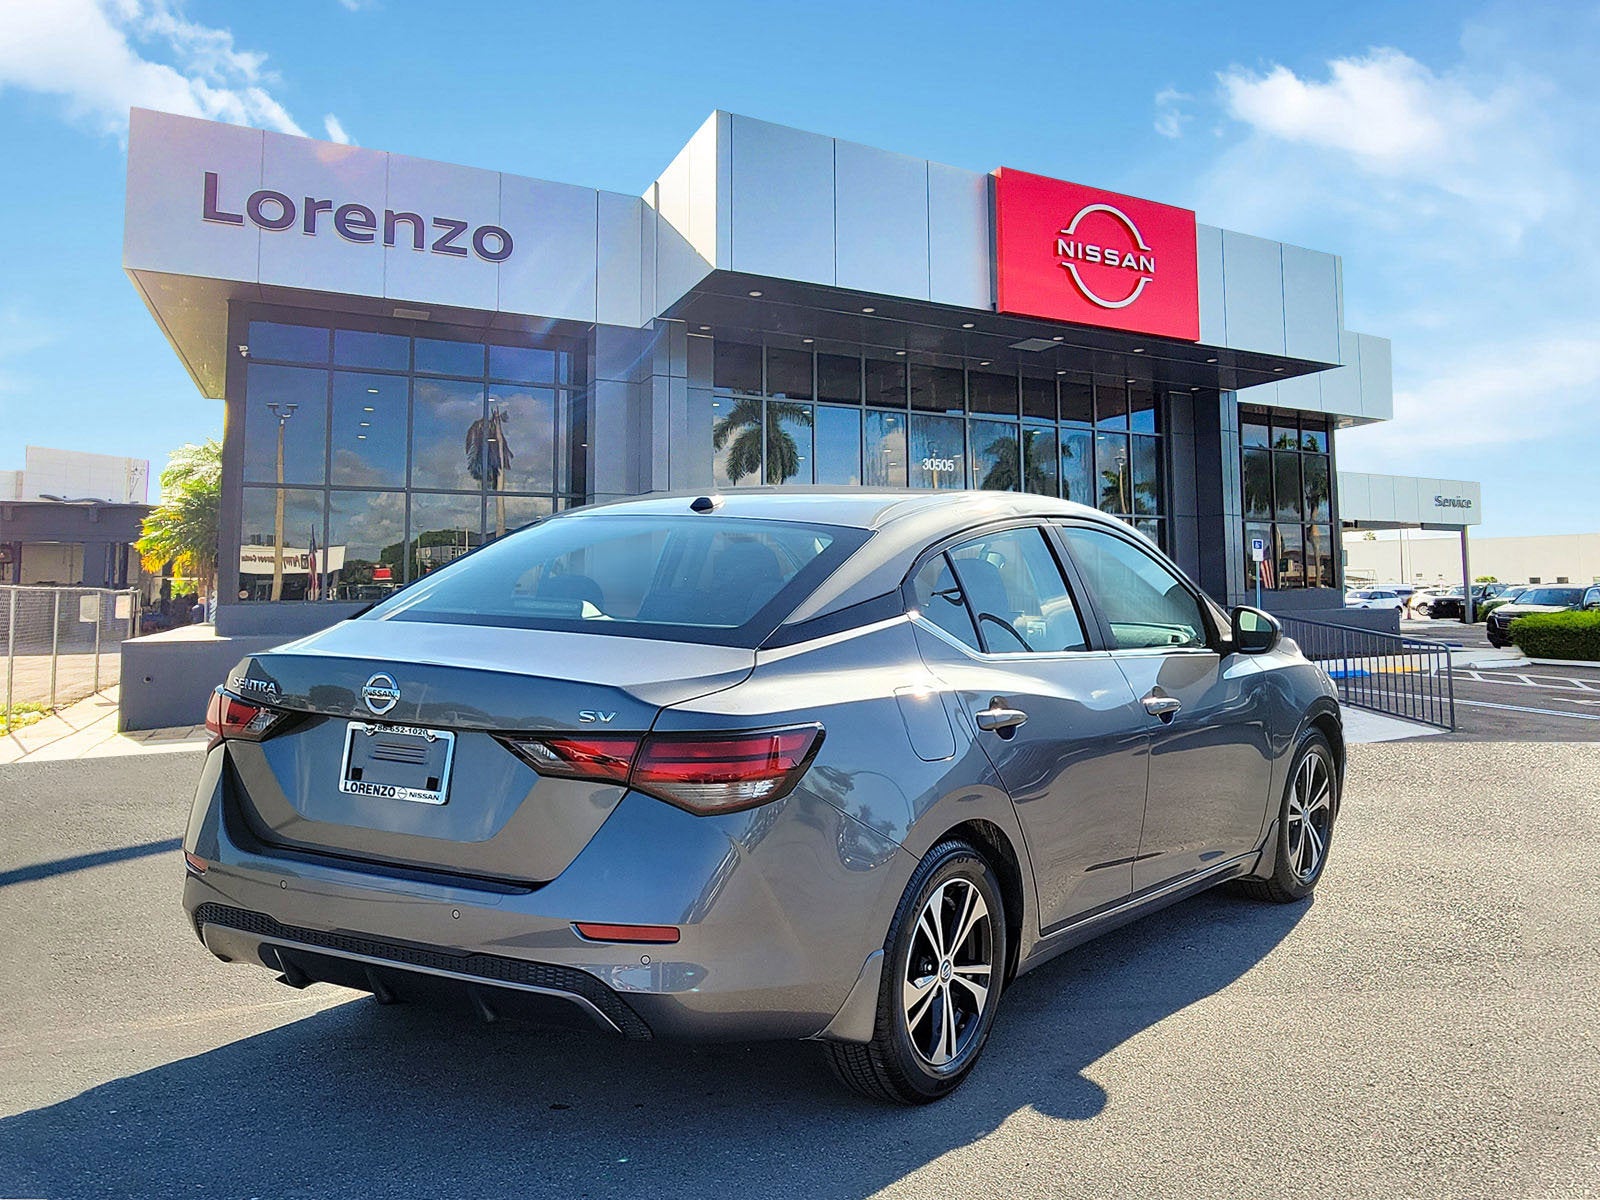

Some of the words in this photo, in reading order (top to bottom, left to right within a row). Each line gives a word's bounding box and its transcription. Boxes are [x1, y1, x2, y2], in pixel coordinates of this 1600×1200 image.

[202, 171, 514, 263] Lorenzo
[1057, 238, 1155, 273] NISSAN
[922, 458, 955, 471] 30505
[1434, 495, 1472, 508] Service
[233, 676, 277, 694] SENTRA
[363, 687, 399, 700] NISSAN
[579, 710, 617, 723] SV
[343, 781, 396, 798] LORENZO
[408, 791, 440, 801] NISSAN
